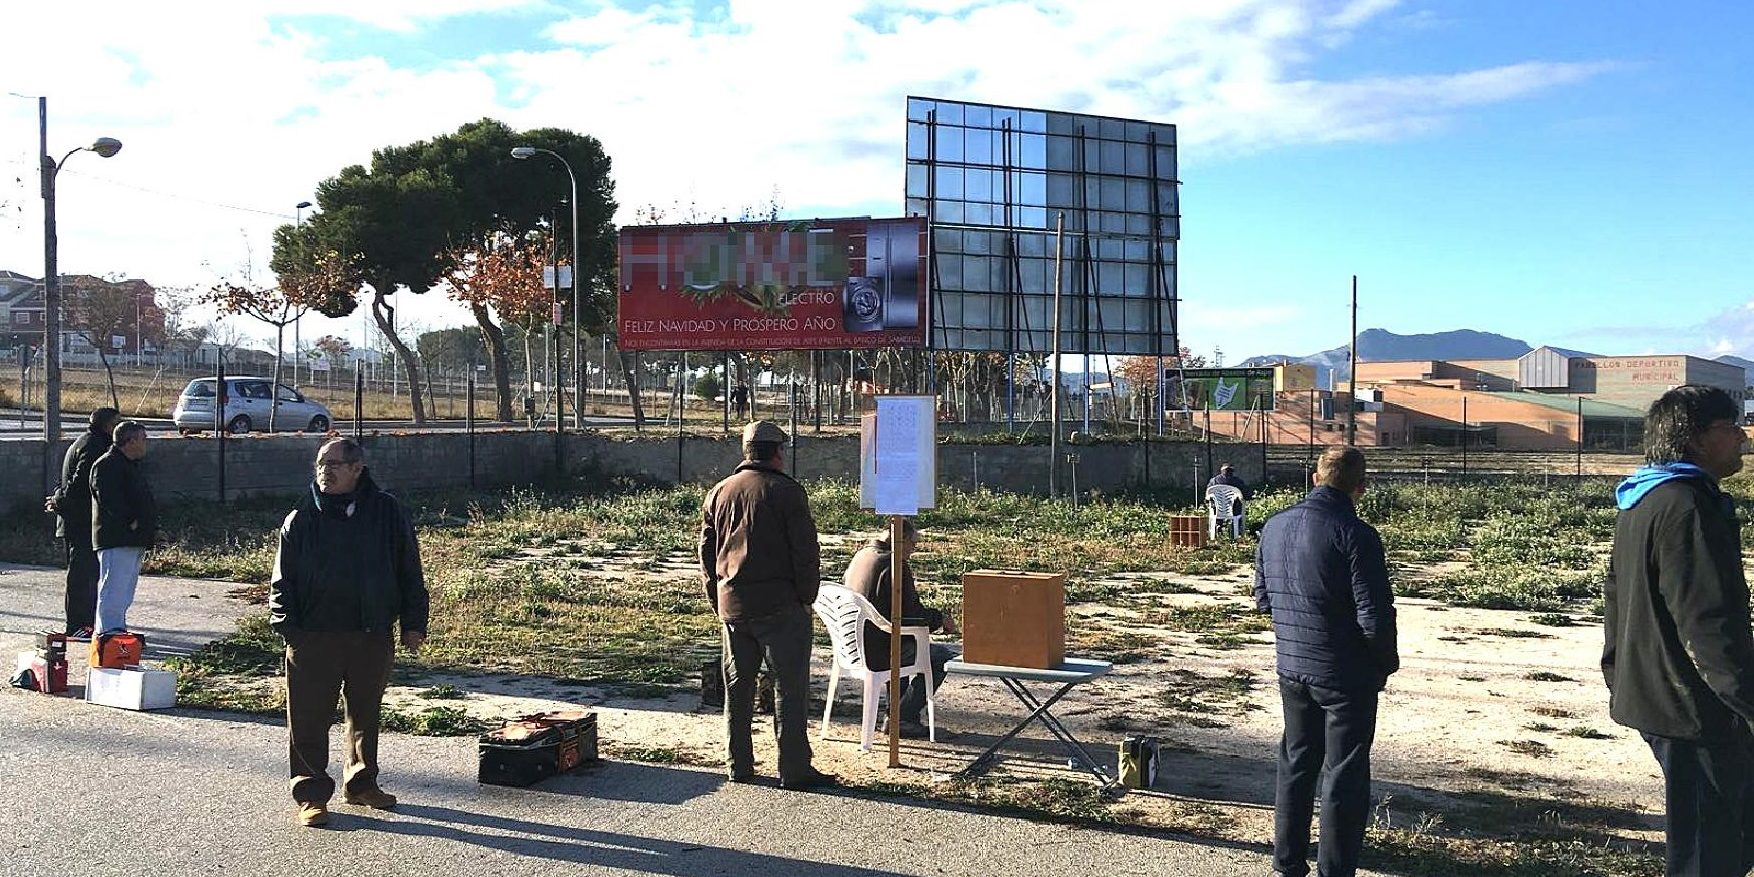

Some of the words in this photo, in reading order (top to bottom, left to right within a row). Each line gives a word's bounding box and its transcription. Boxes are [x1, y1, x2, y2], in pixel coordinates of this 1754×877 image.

[624, 320, 654, 333] FELIZ
[659, 318, 716, 333] NAVIDAD
[719, 319, 729, 331] Y
[803, 315, 836, 331] AÑO
[1626, 359, 1679, 368] DEPORTIVO
[1632, 372, 1679, 381] MUNICIPAL
